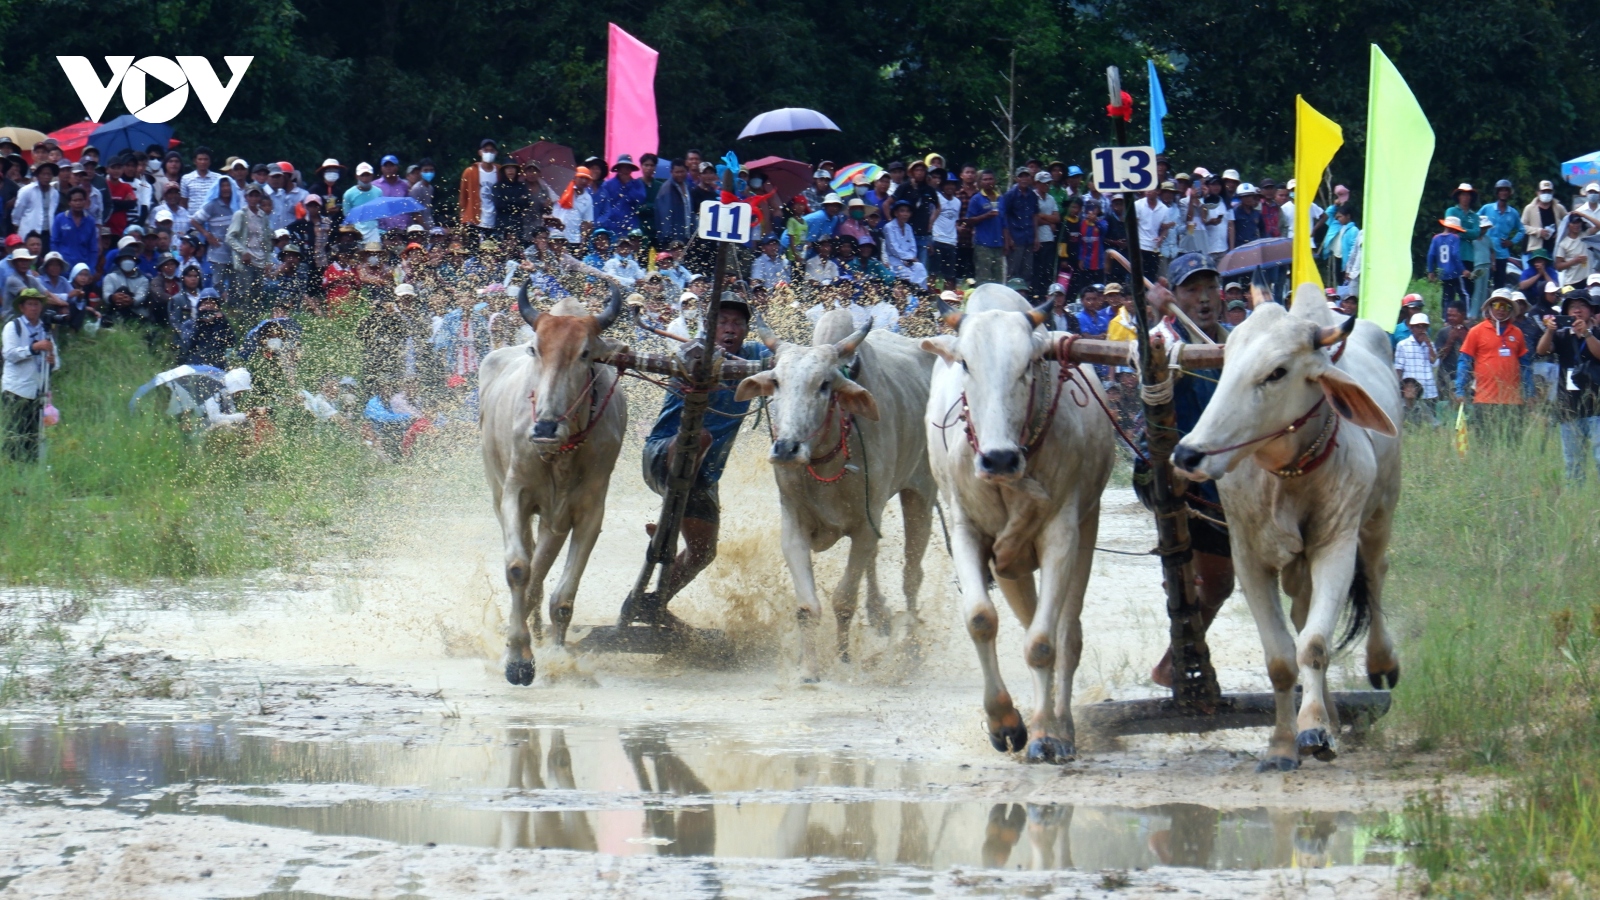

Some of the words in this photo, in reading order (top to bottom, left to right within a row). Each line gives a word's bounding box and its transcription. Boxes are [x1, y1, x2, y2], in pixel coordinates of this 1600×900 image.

[1095, 149, 1152, 190] 13
[706, 204, 742, 240] 11
[1440, 244, 1449, 263] 8
